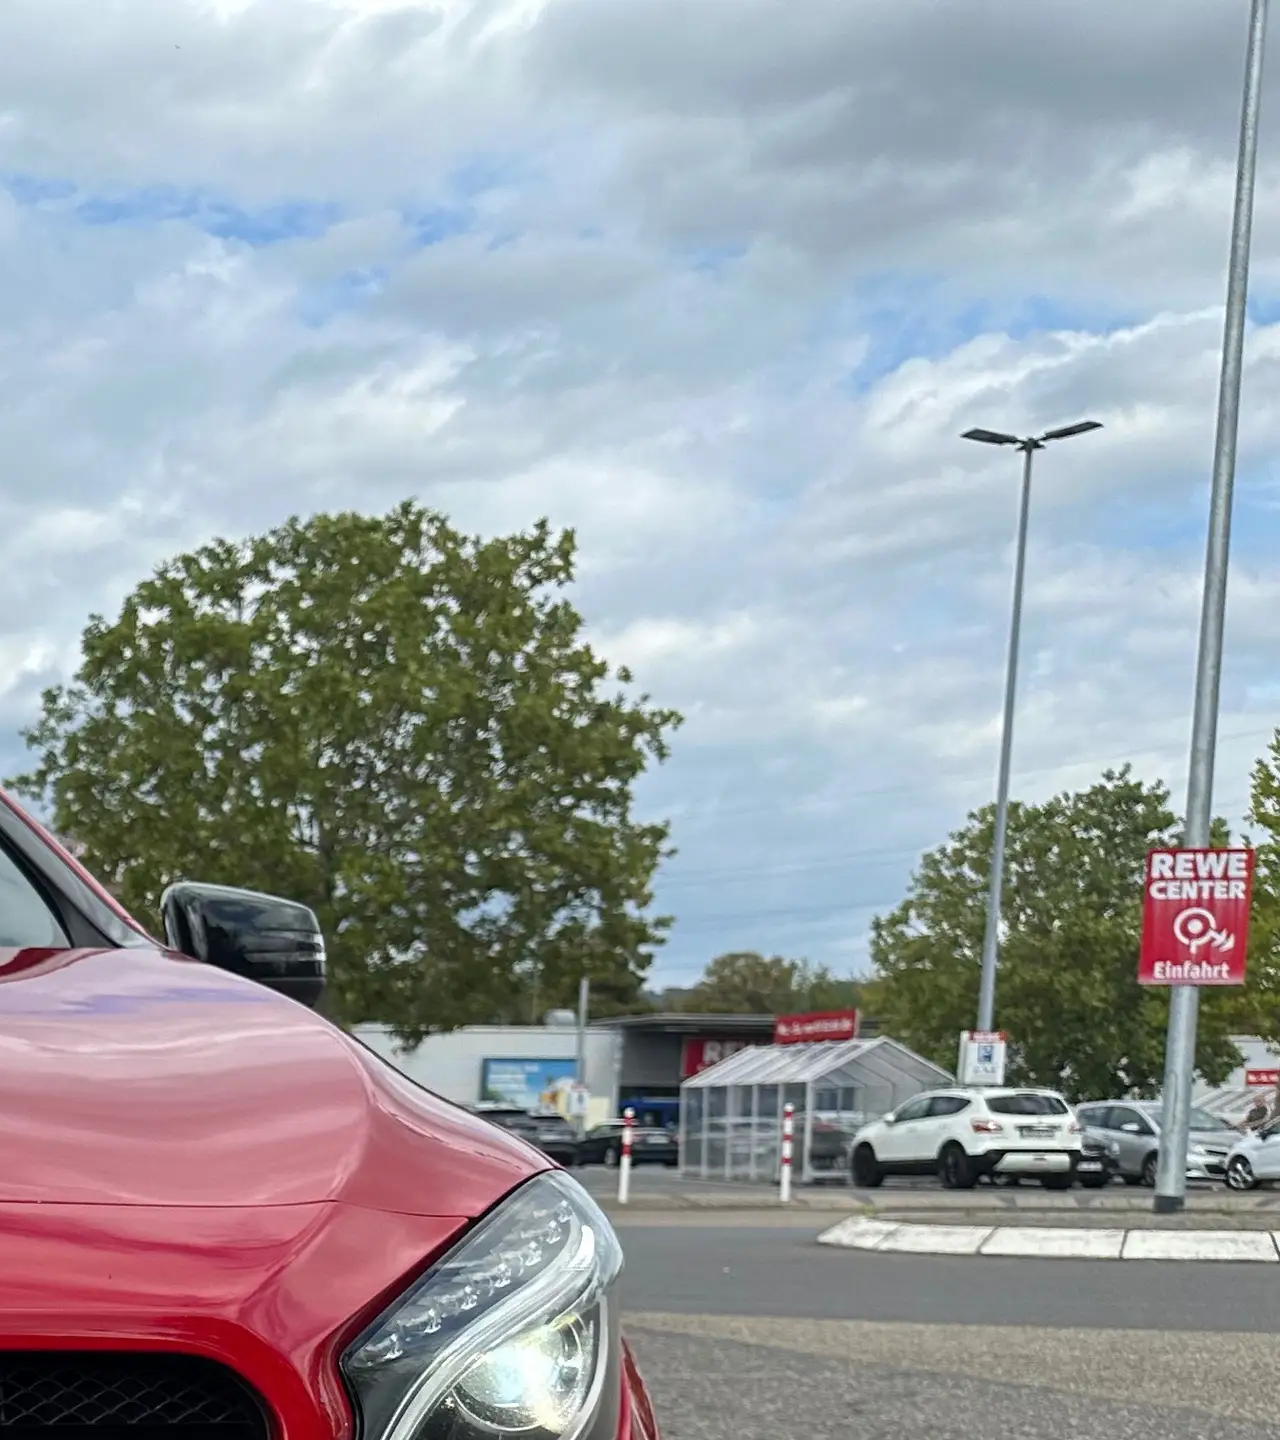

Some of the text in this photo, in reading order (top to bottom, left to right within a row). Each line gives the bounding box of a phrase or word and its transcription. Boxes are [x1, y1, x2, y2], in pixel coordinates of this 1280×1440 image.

[1151, 852, 1248, 879] REWE
[1149, 880, 1247, 900] CENTER
[1153, 961, 1230, 979] Einfahrt
